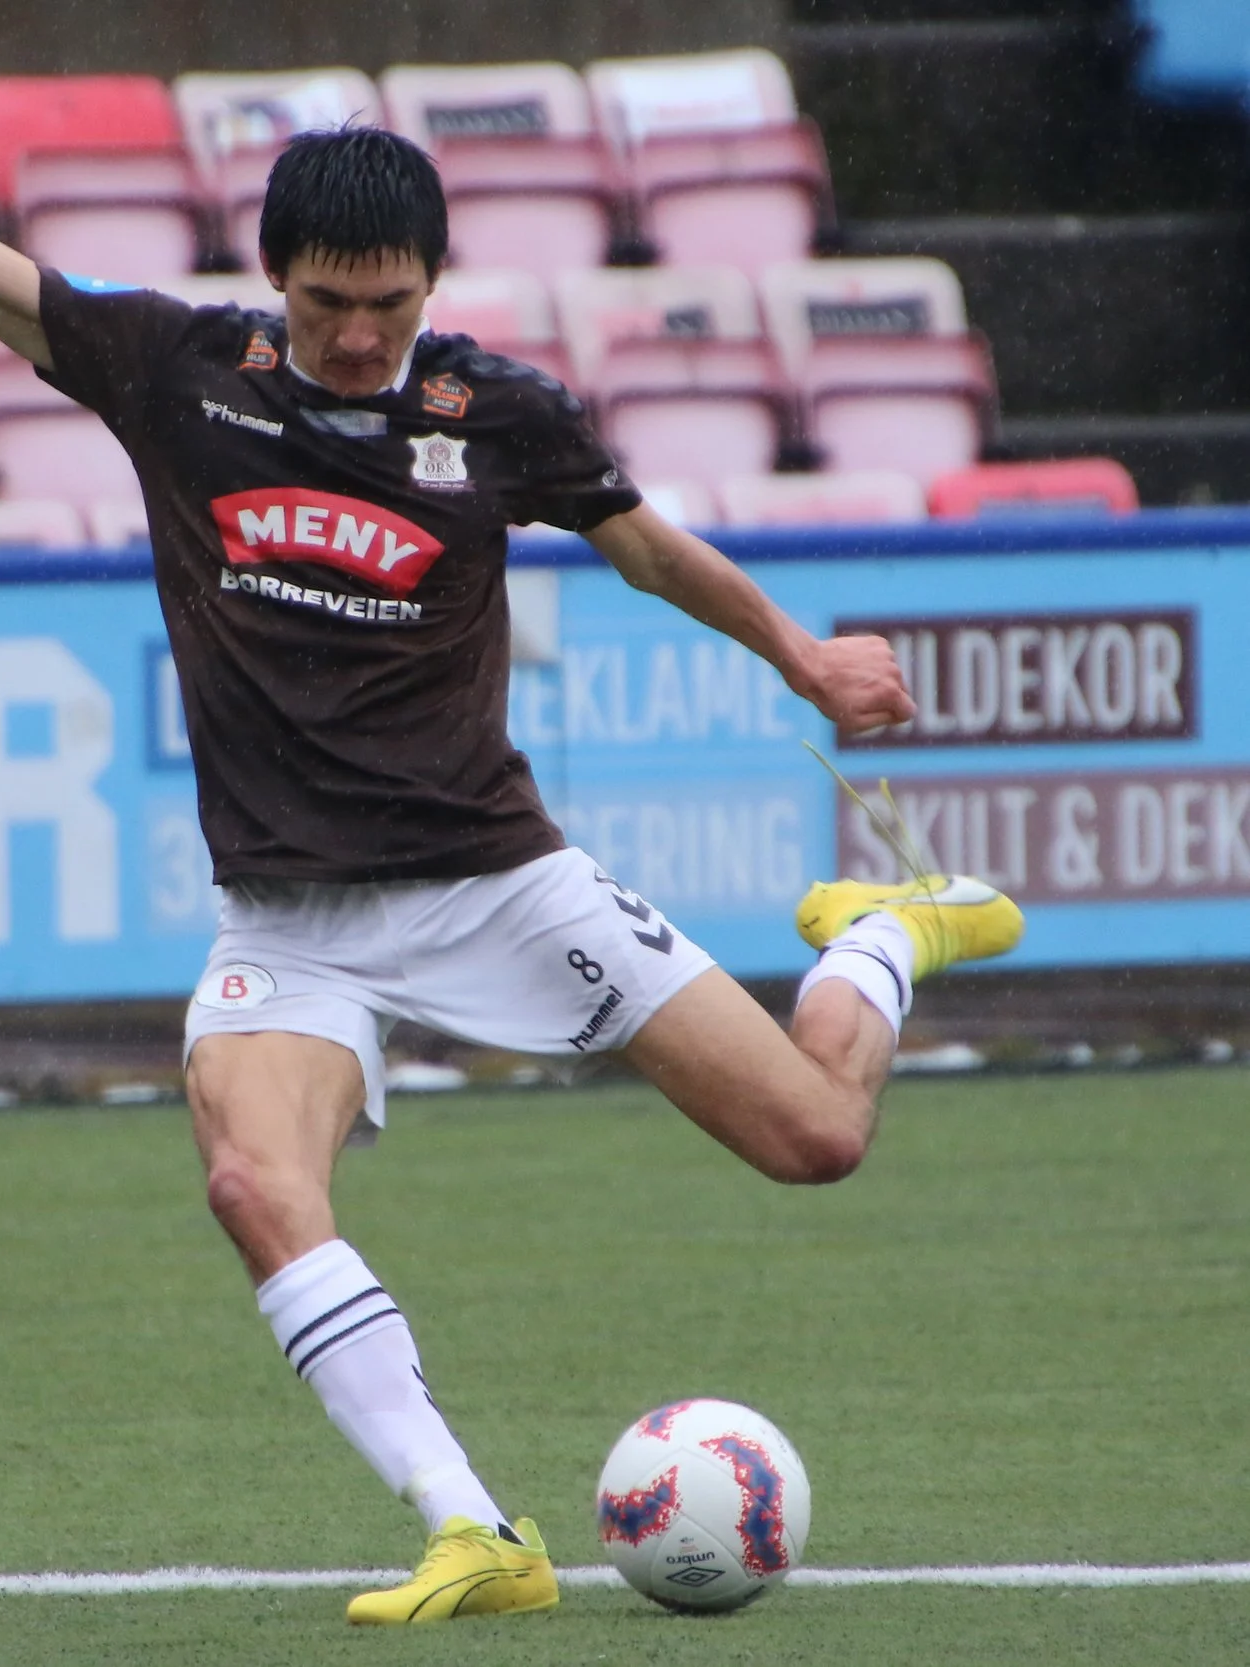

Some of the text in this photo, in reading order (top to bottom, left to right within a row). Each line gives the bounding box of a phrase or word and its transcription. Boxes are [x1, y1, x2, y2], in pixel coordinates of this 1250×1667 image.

[221, 404, 284, 437] hummel
[238, 505, 420, 573] MENY
[220, 567, 422, 621] BORREVEIEN
[850, 623, 1184, 740] ILDEKOR
[851, 785, 1038, 892] SKILT
[1046, 784, 1105, 891] &
[221, 975, 249, 1000] B
[567, 948, 604, 984] 8
[568, 984, 624, 1052] hummel
[666, 1551, 716, 1565] umbro
